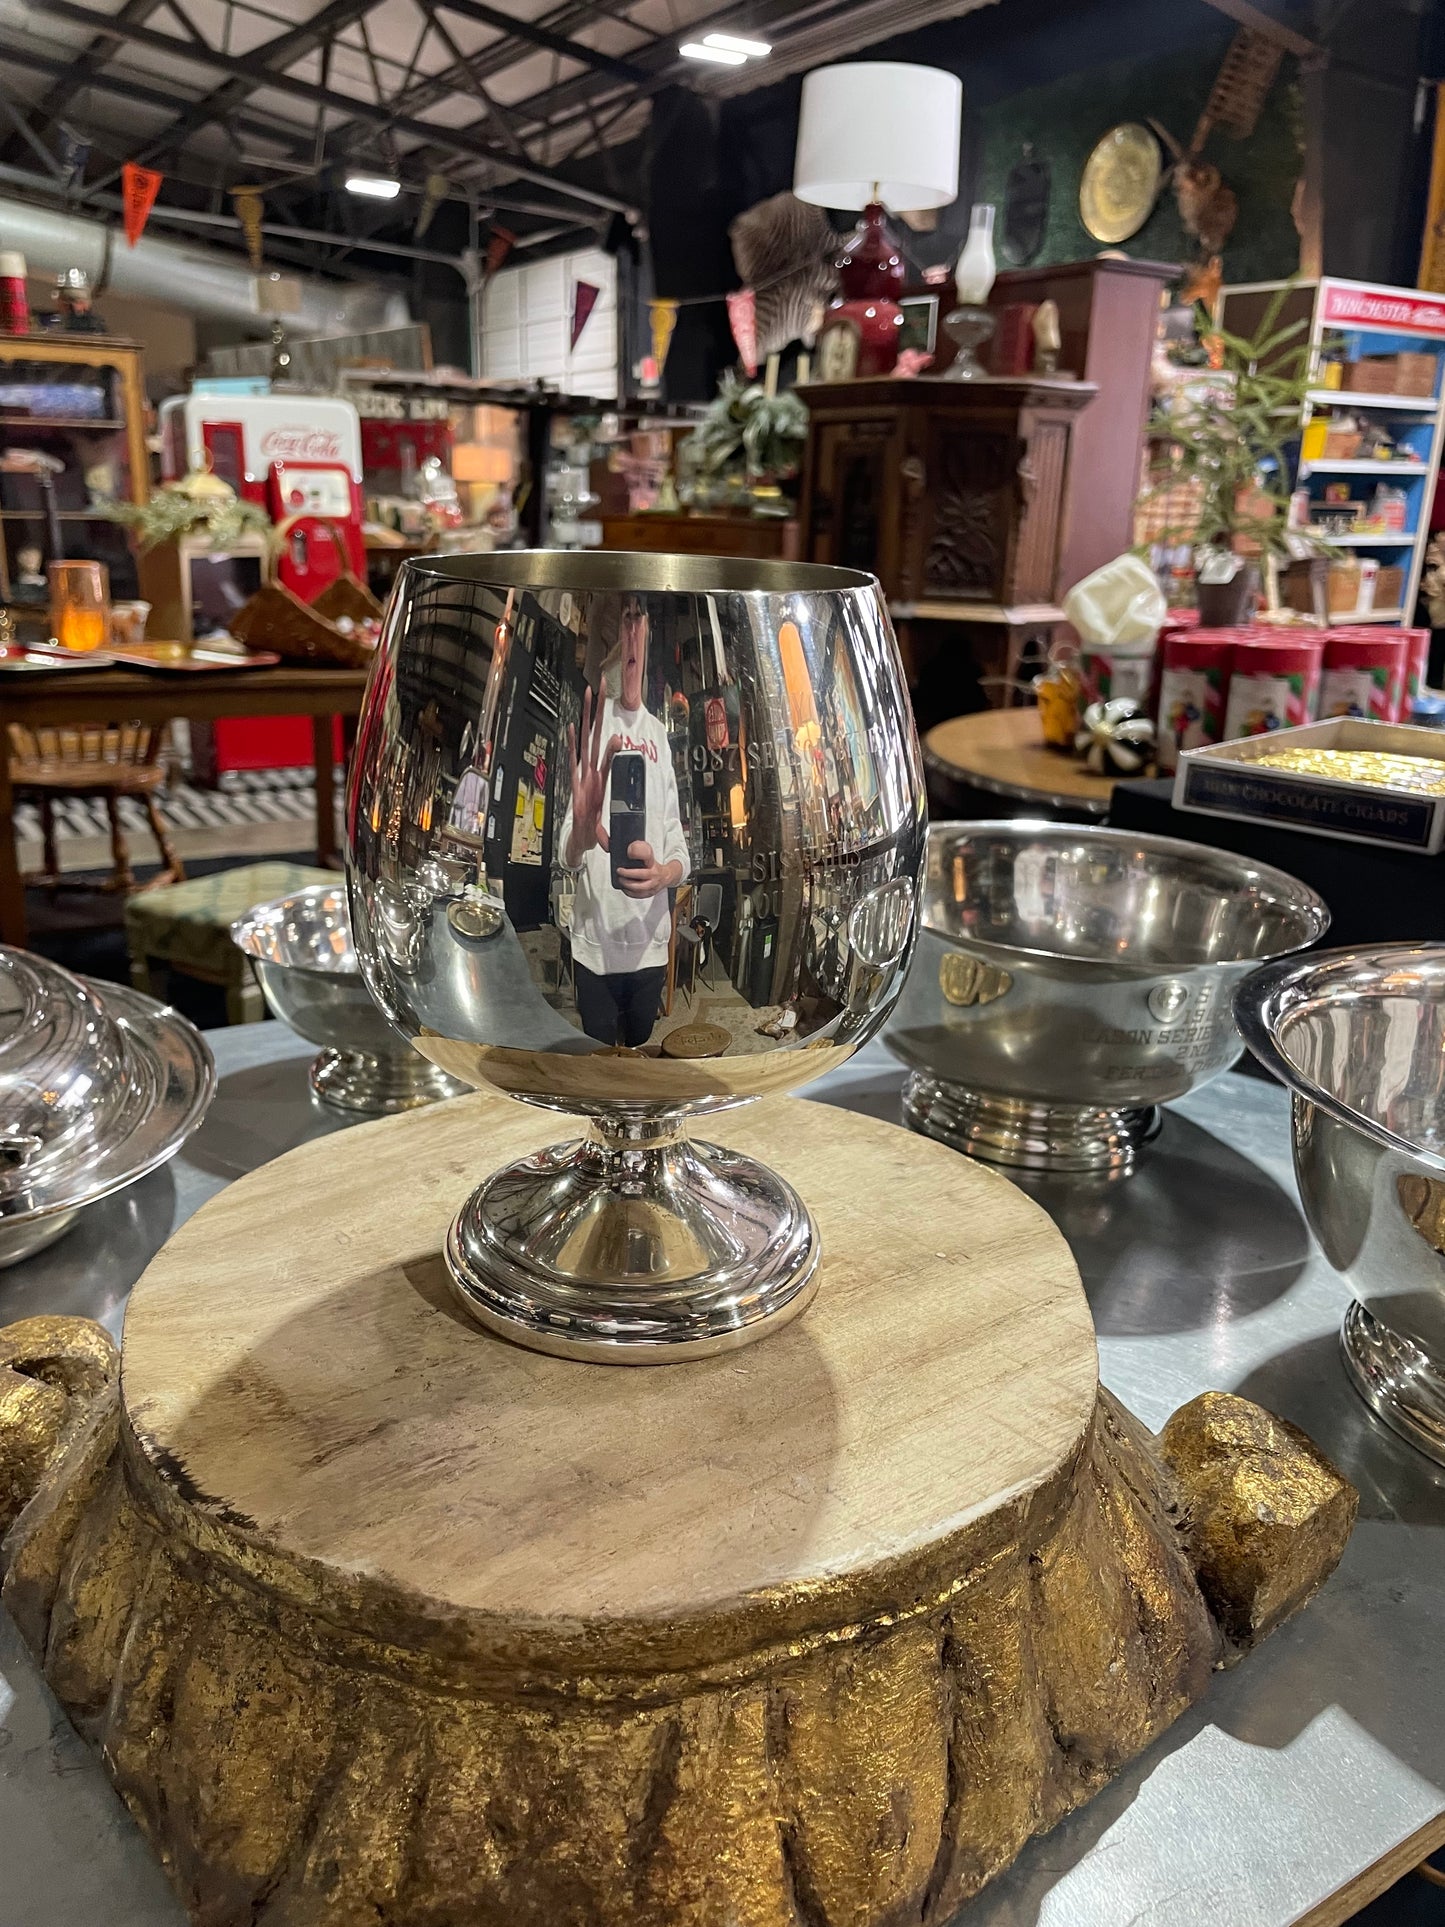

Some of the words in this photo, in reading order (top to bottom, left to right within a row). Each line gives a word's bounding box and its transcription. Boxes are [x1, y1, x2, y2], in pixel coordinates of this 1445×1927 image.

[684, 742, 739, 772] 1987
[1242, 783, 1337, 814] CHOCOLATE
[1344, 799, 1409, 826] CIGARS
[1157, 1024, 1219, 1045] SERIE
